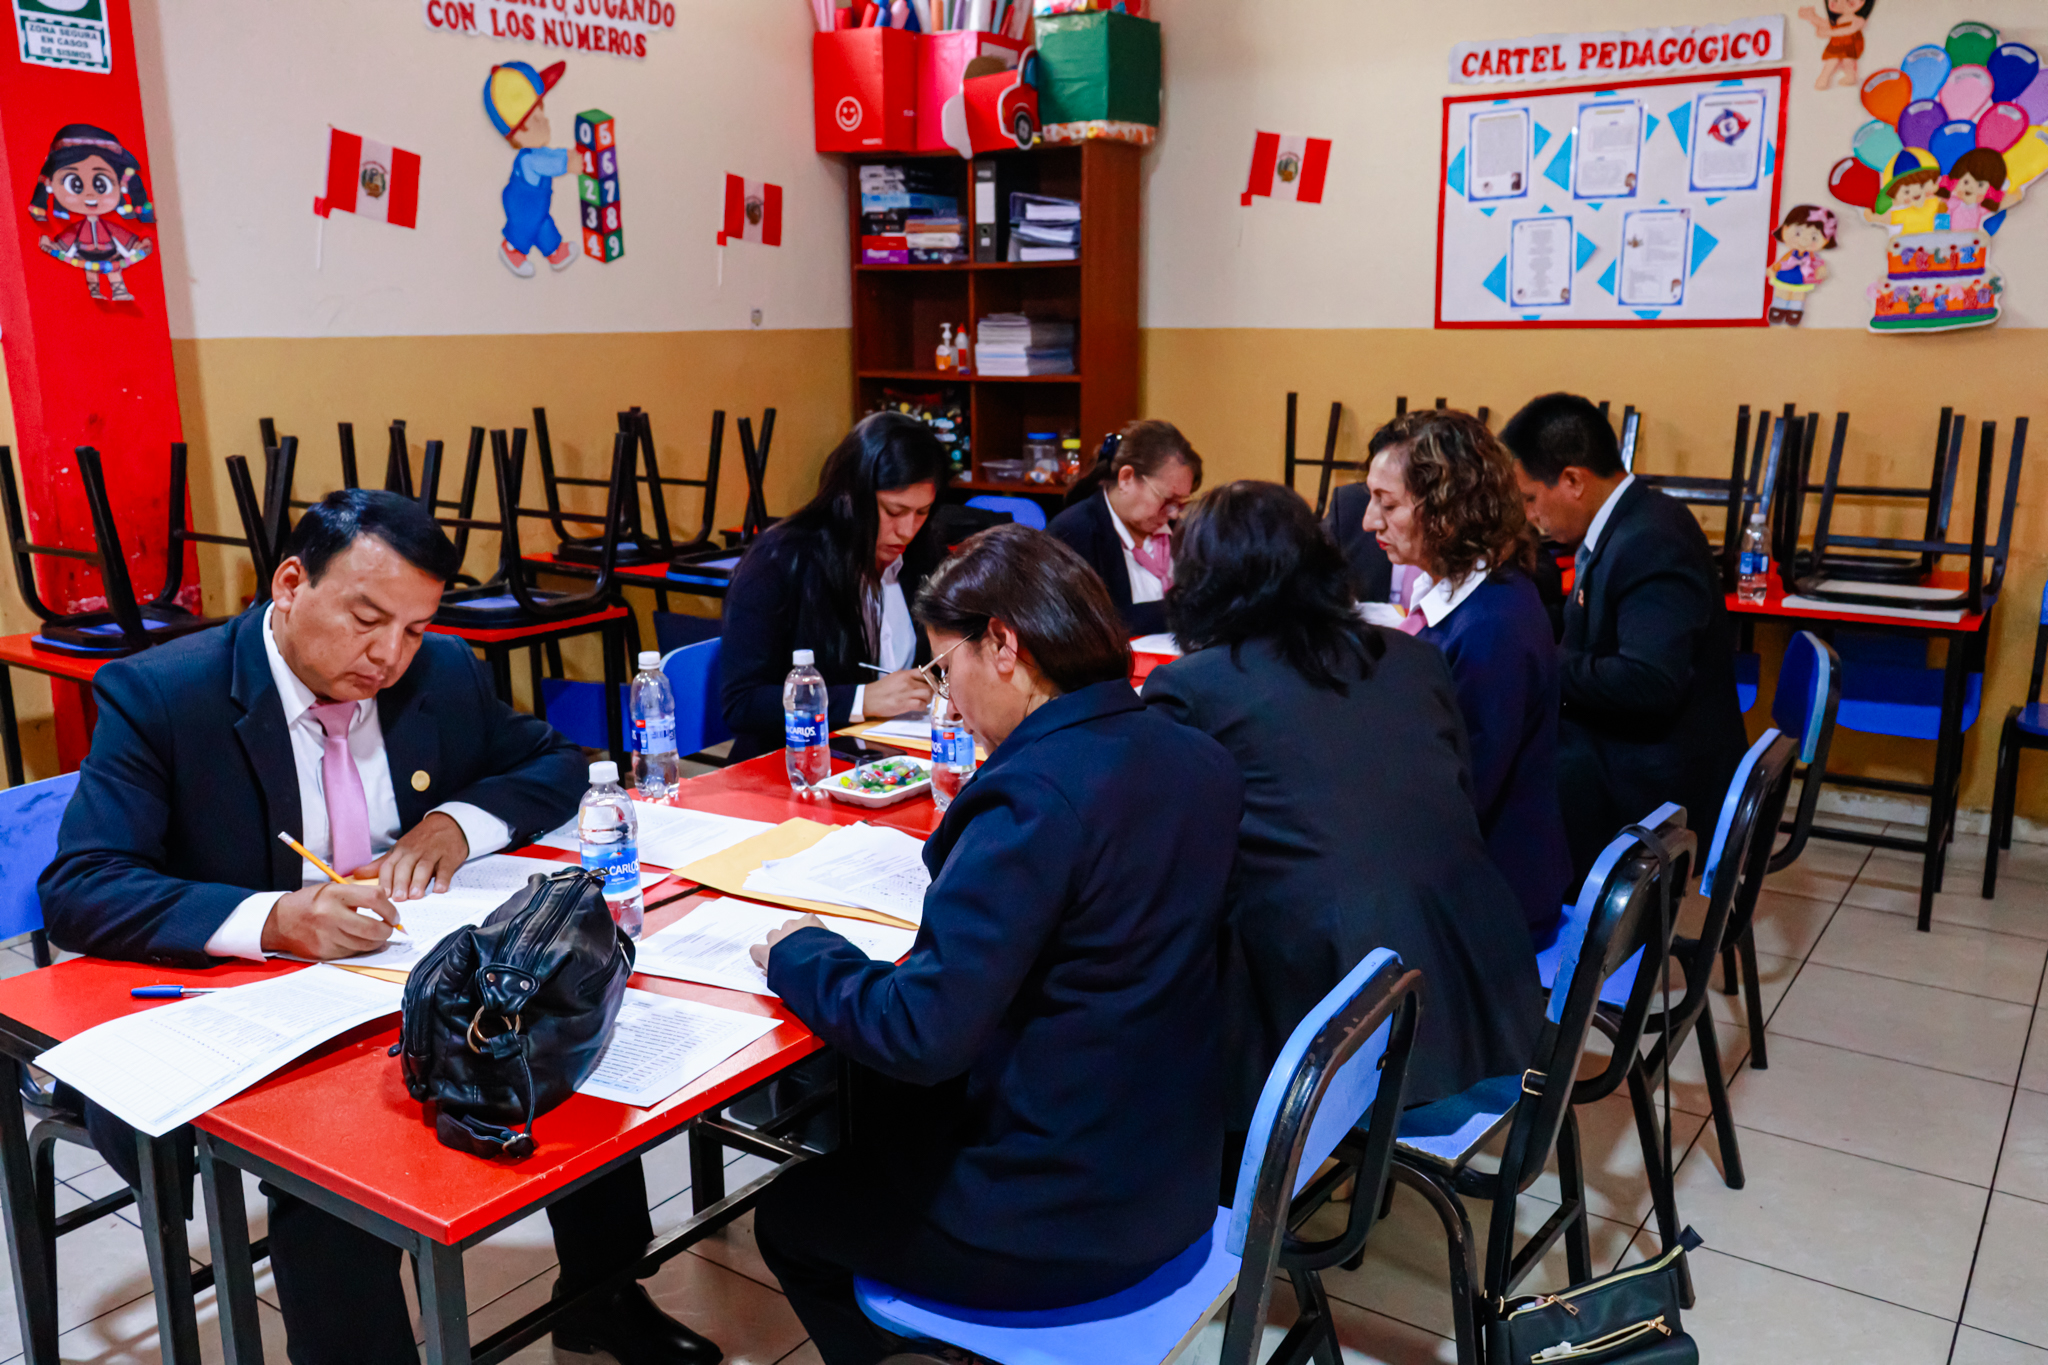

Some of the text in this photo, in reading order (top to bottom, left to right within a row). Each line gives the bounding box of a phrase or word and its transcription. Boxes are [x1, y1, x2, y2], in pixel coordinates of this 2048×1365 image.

[574, 0, 676, 27] JUGANDO
[29, 24, 98, 40] ZONA SEGURA
[427, 0, 647, 58] CON LOS NÚMEROS
[41, 35, 89, 48] EN CASOS
[1461, 28, 1772, 77] CARTEL PEDAGÓGICO
[40, 46, 92, 60] DE SISMOS
[579, 122, 592, 144] 0
[600, 123, 612, 145] 5
[584, 151, 595, 173] 1
[602, 151, 614, 174] 6
[584, 179, 597, 200] 2
[604, 180, 616, 203] 7
[586, 206, 598, 229] 3
[606, 206, 618, 230] 8
[587, 235, 602, 257] 4
[608, 236, 620, 257] 9
[609, 858, 640, 876] CARLOS
